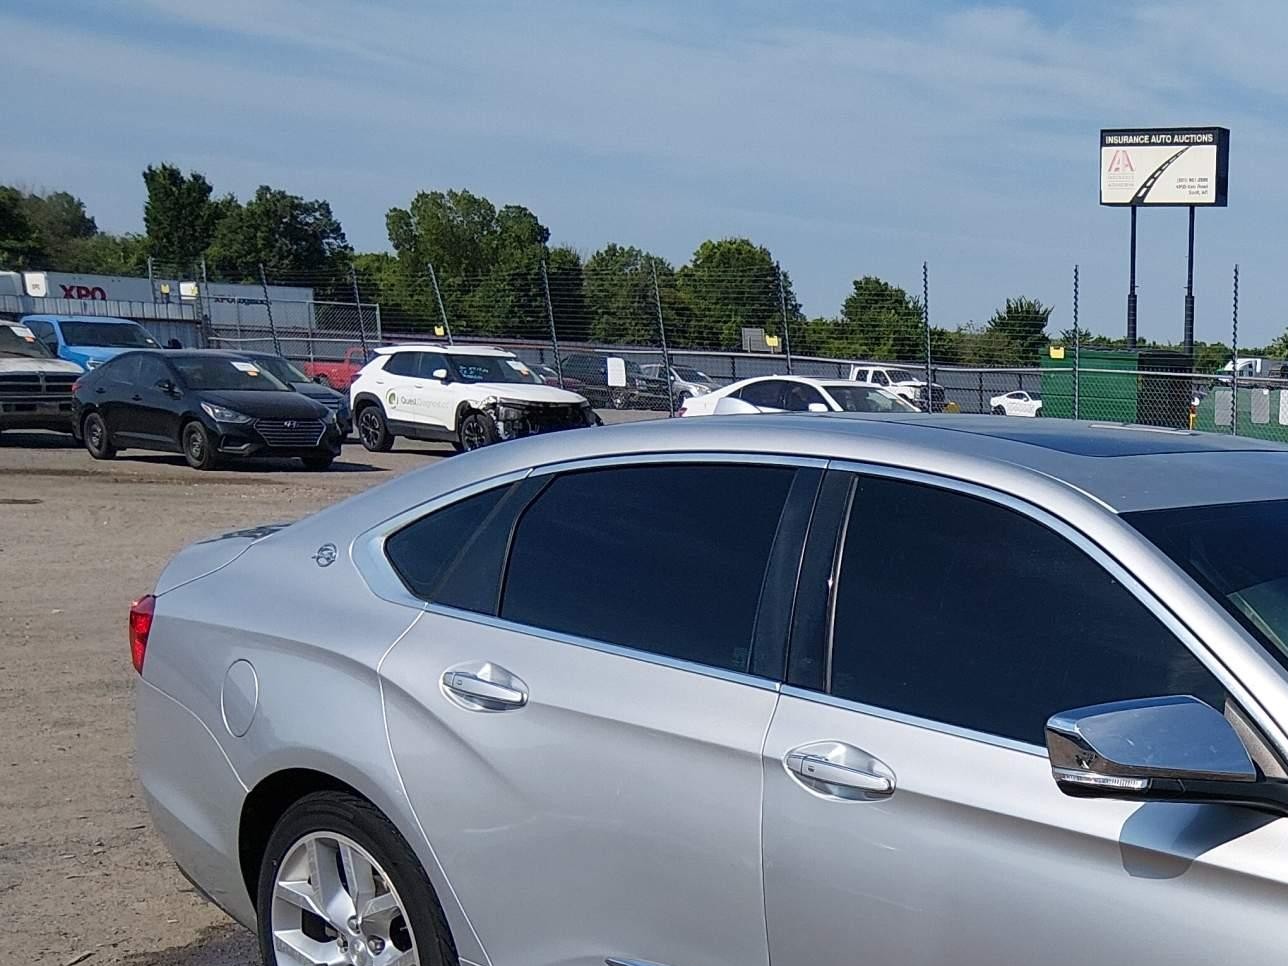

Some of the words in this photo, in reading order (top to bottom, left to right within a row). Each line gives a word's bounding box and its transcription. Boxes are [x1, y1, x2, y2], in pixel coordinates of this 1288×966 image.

[1106, 135, 1149, 144] INSURANCE
[1151, 134, 1172, 144] AUTO
[1174, 134, 1213, 143] AUCTIONS
[59, 284, 107, 300] XPO
